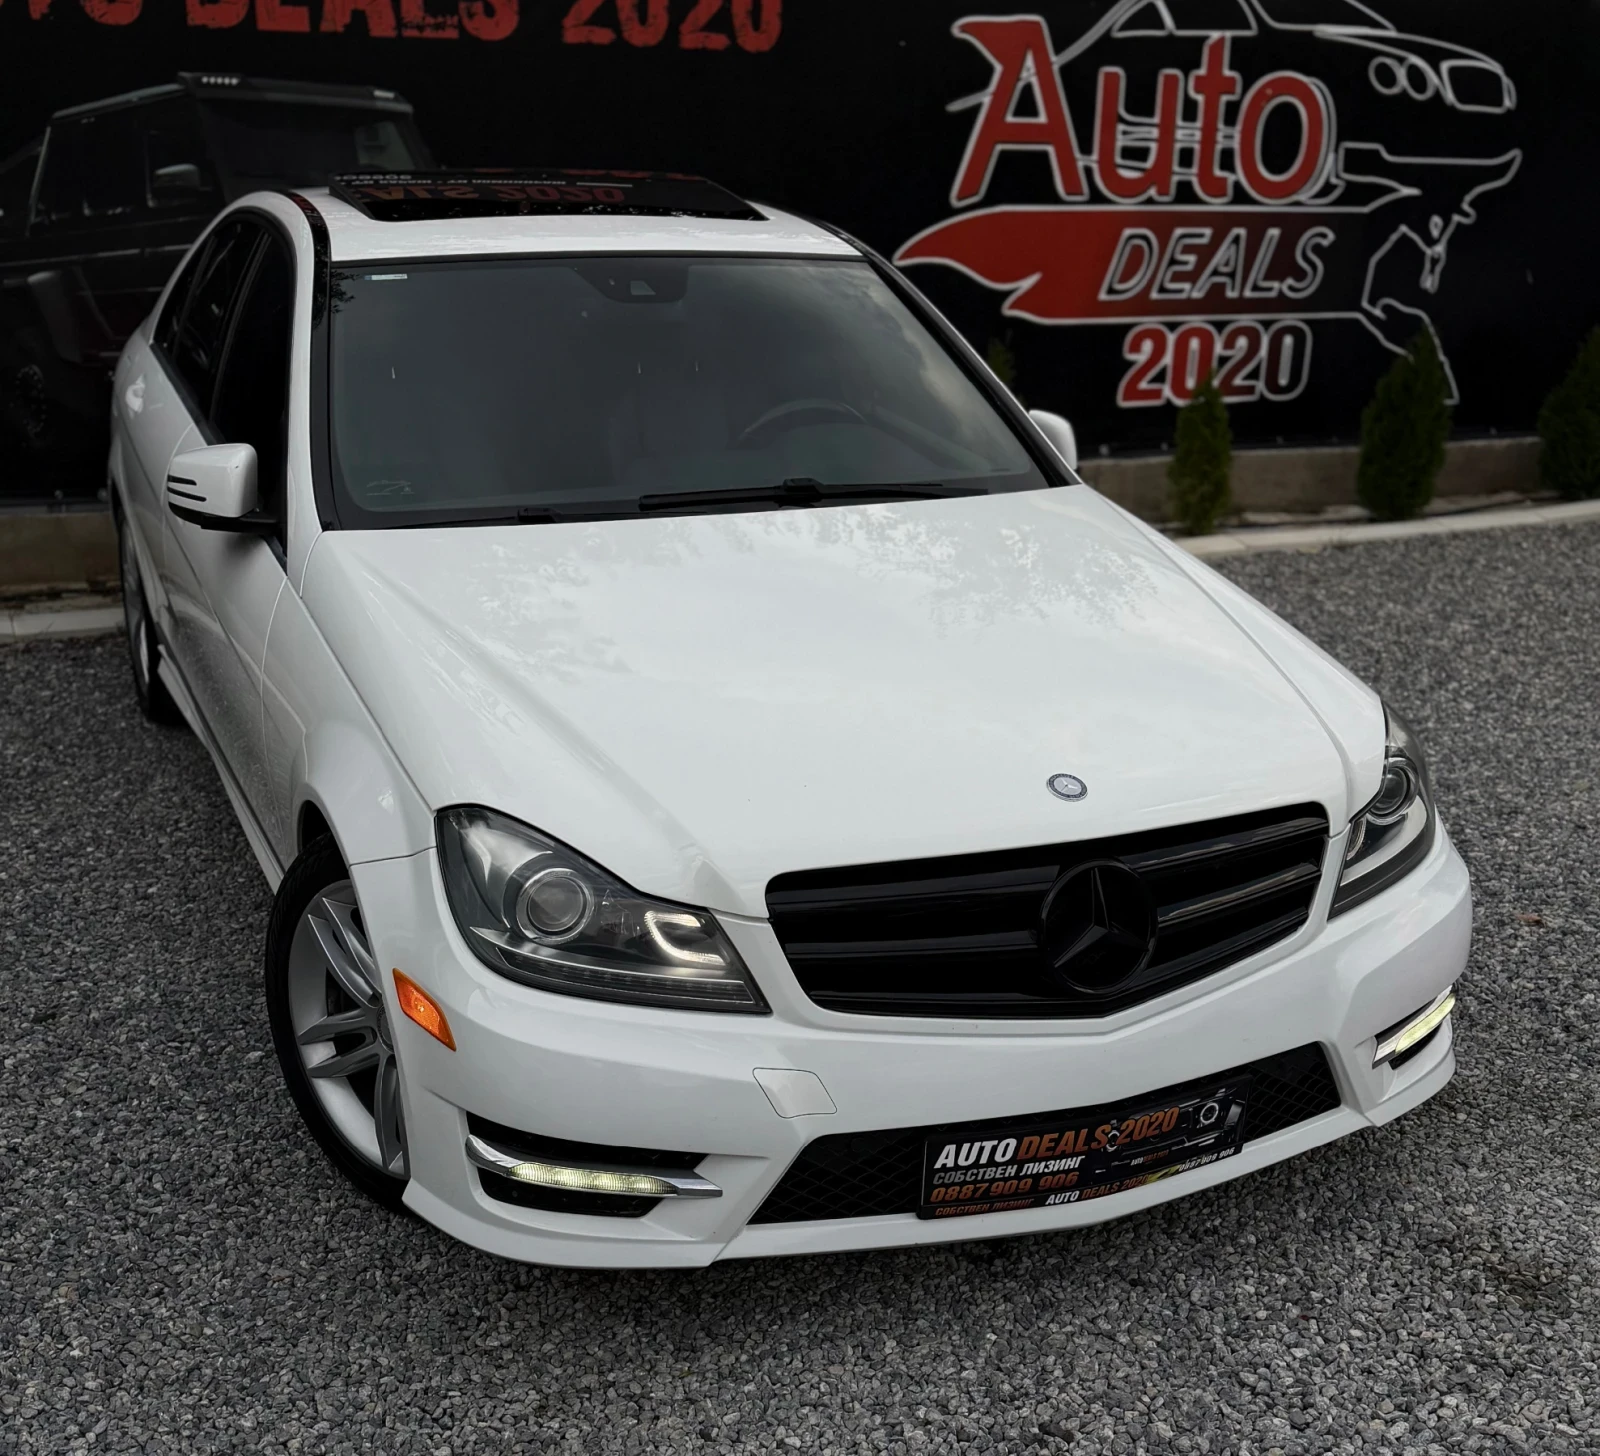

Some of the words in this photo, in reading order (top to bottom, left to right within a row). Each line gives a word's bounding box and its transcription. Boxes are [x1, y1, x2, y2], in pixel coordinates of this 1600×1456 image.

[951, 15, 1330, 206] Auto
[1099, 227, 1336, 301] DEALS
[1117, 321, 1312, 407] 2020
[933, 1138, 1018, 1169] AUTO
[1016, 1124, 1112, 1160] DEALS
[1116, 1106, 1180, 1145] 2020
[933, 1164, 1018, 1185] СОБСТВЕН
[1019, 1155, 1086, 1177] ЛИЗИНГ
[1038, 1171, 1080, 1191] 906
[935, 1203, 990, 1217] СОБСТВЕН
[1045, 1190, 1080, 1206] AUTO
[1081, 1181, 1119, 1200] DEALS
